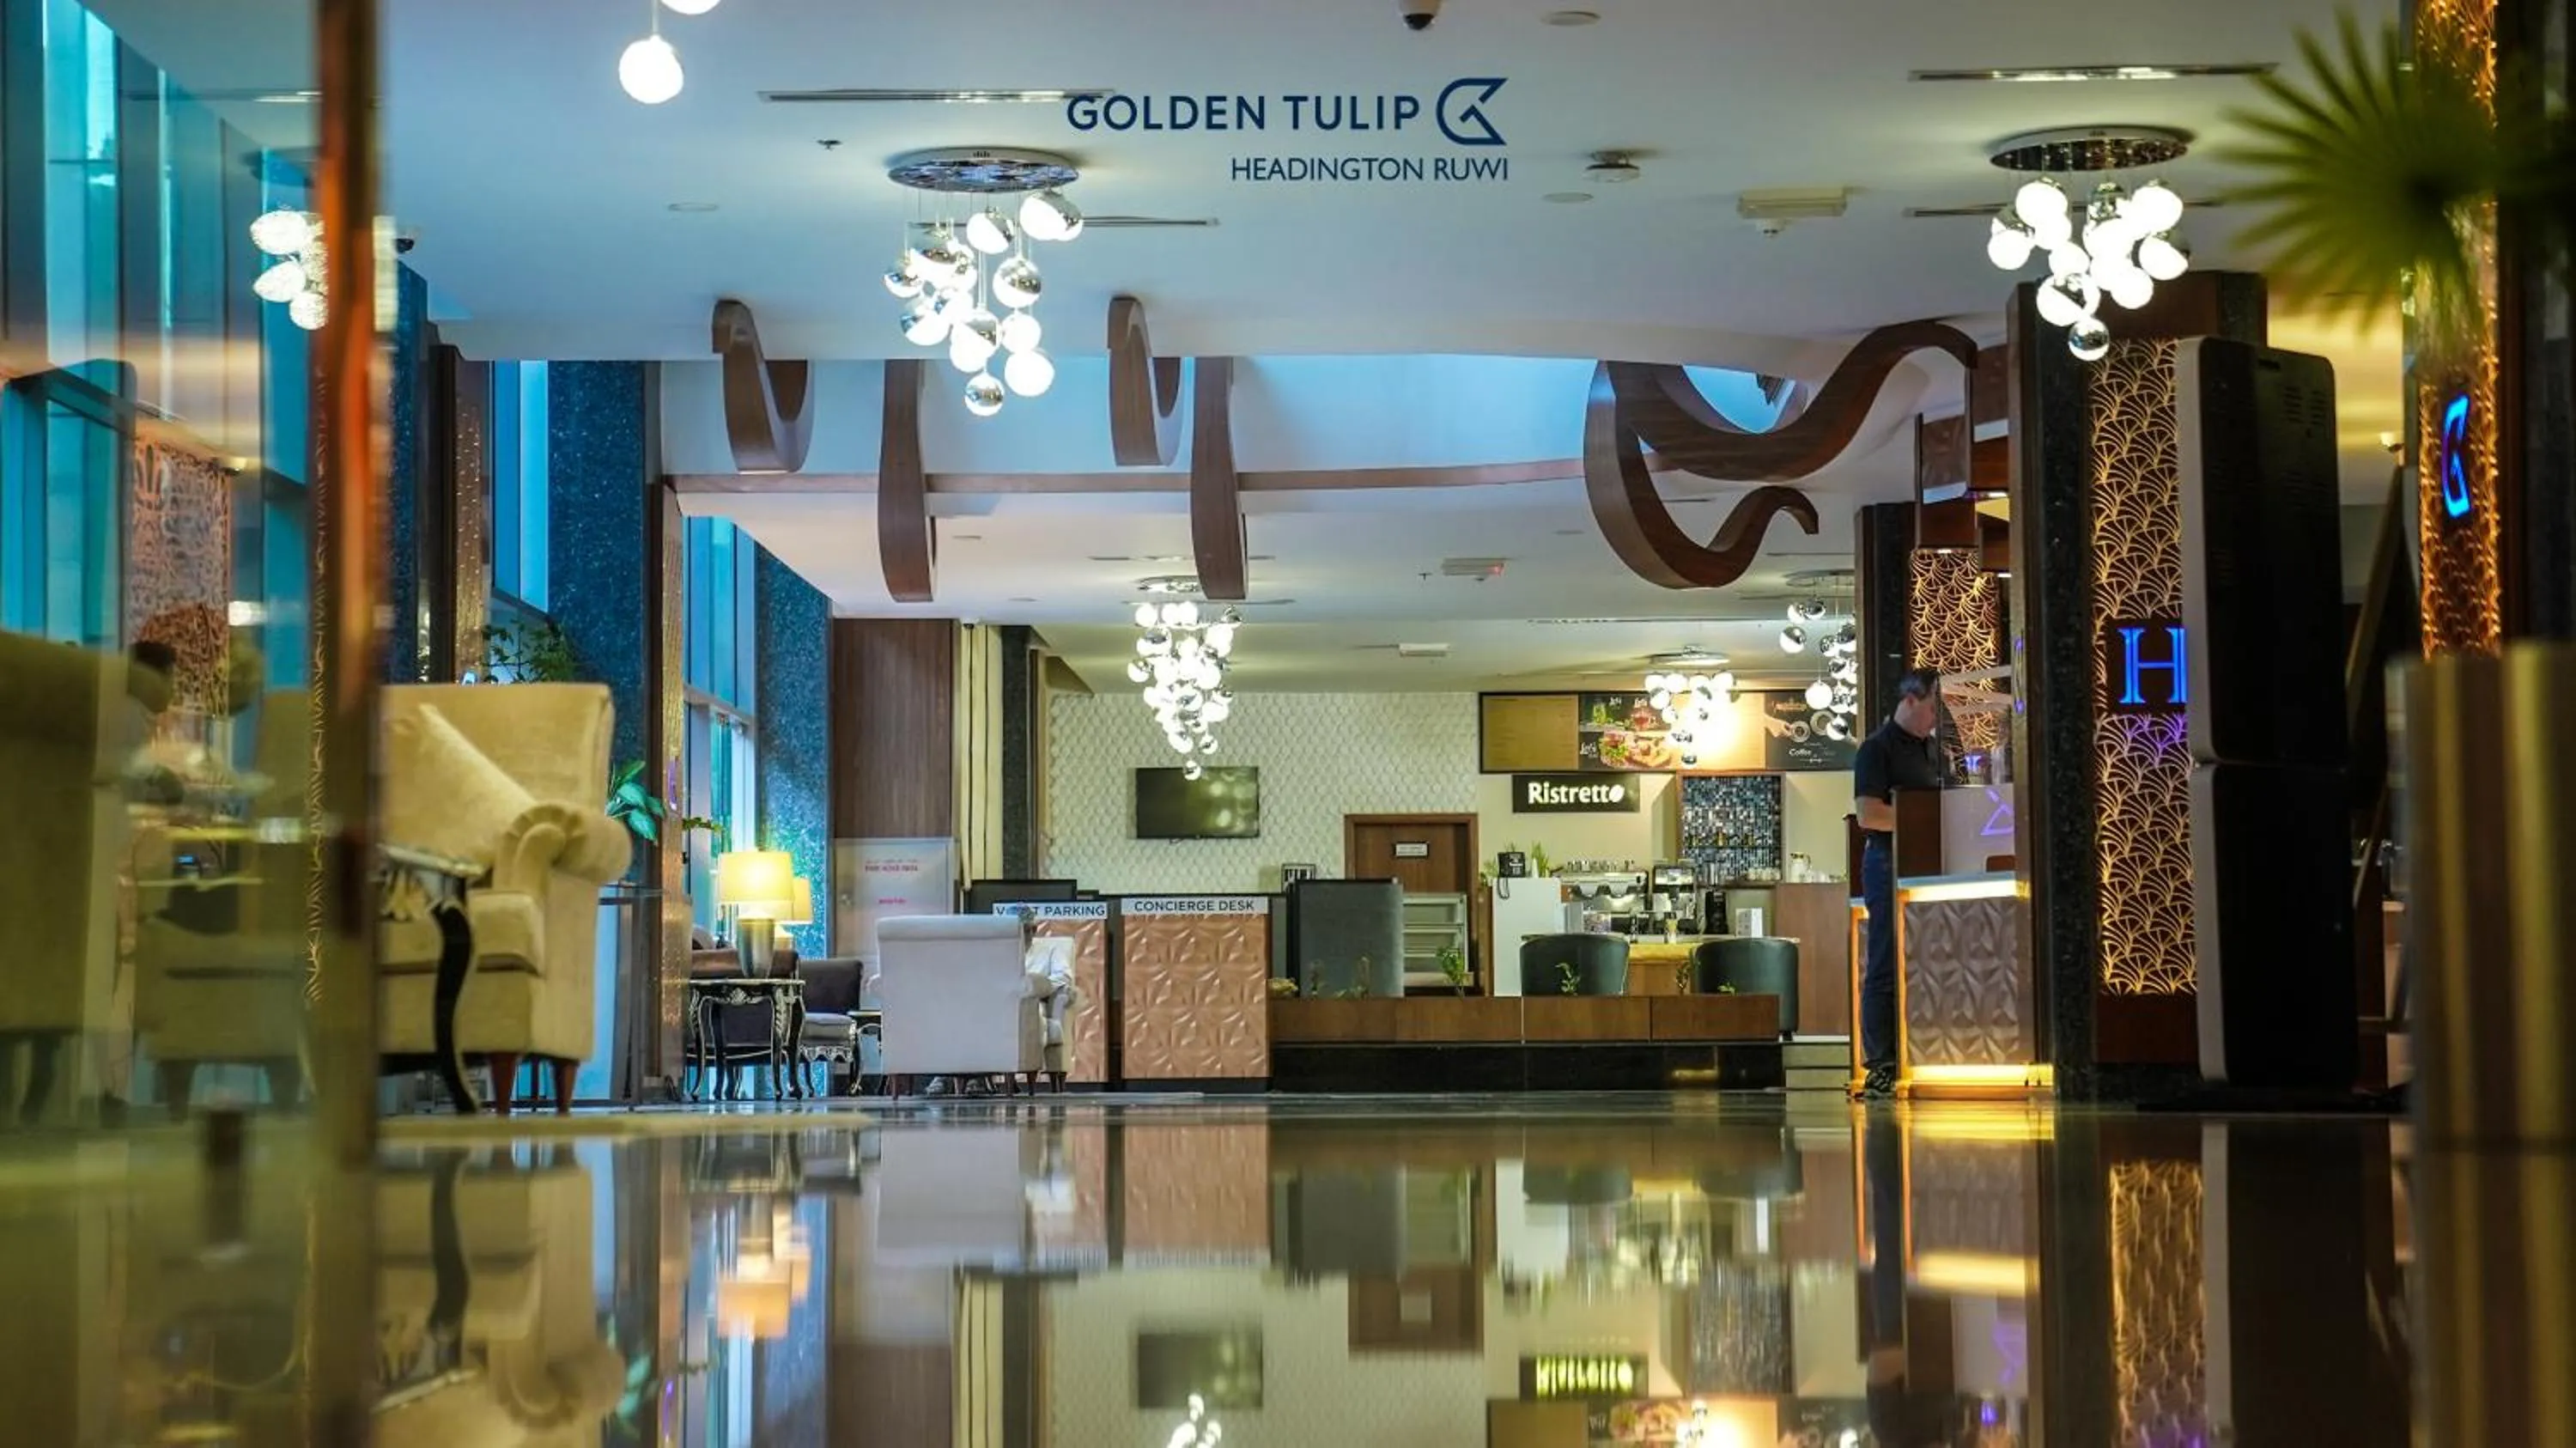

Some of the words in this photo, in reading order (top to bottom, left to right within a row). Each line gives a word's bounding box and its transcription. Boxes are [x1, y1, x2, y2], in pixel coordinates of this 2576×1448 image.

[2117, 627, 2187, 704] H
[1528, 782, 1625, 804] Ristretto
[1044, 906, 1105, 916] PARKING
[1134, 900, 1215, 911] CONCIERGE
[1218, 900, 1255, 910] DESK
